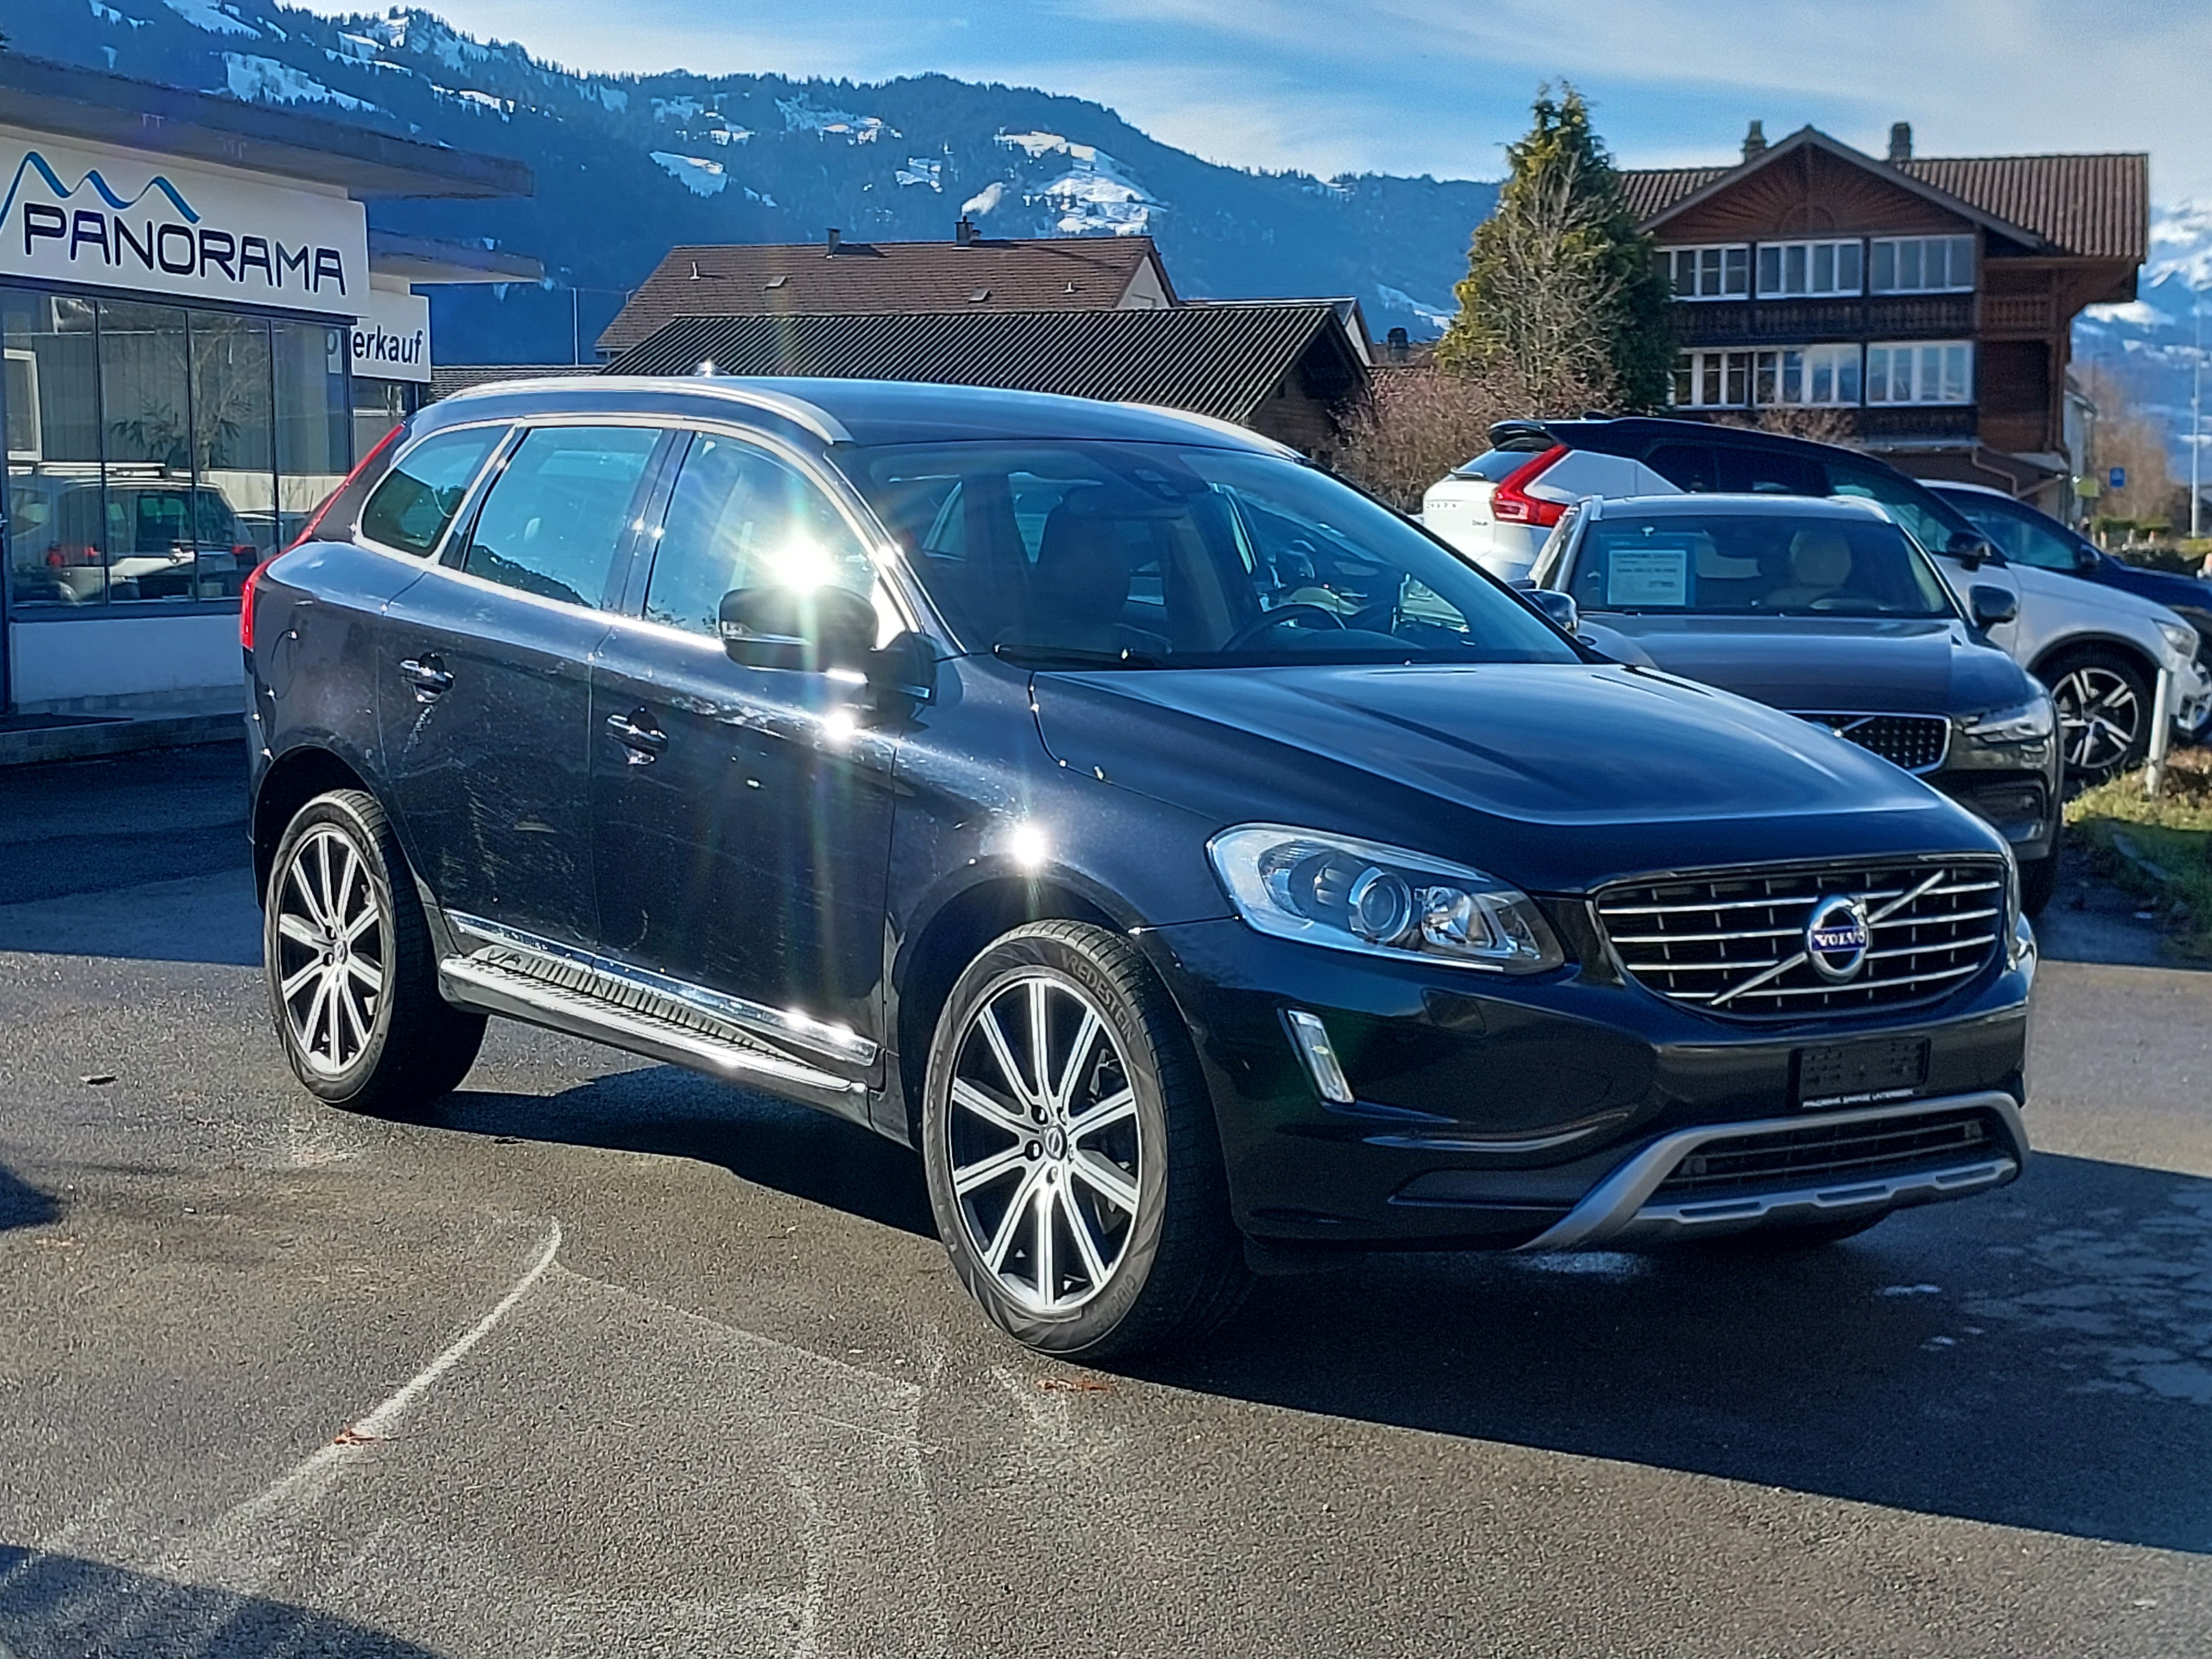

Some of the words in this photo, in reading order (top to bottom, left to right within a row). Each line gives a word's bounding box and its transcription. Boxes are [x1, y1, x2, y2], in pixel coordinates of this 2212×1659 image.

[23, 202, 346, 295] PANORAMA
[1814, 931, 1865, 947] VOLVO
[1061, 949, 1136, 1043] VREDESTEIN
